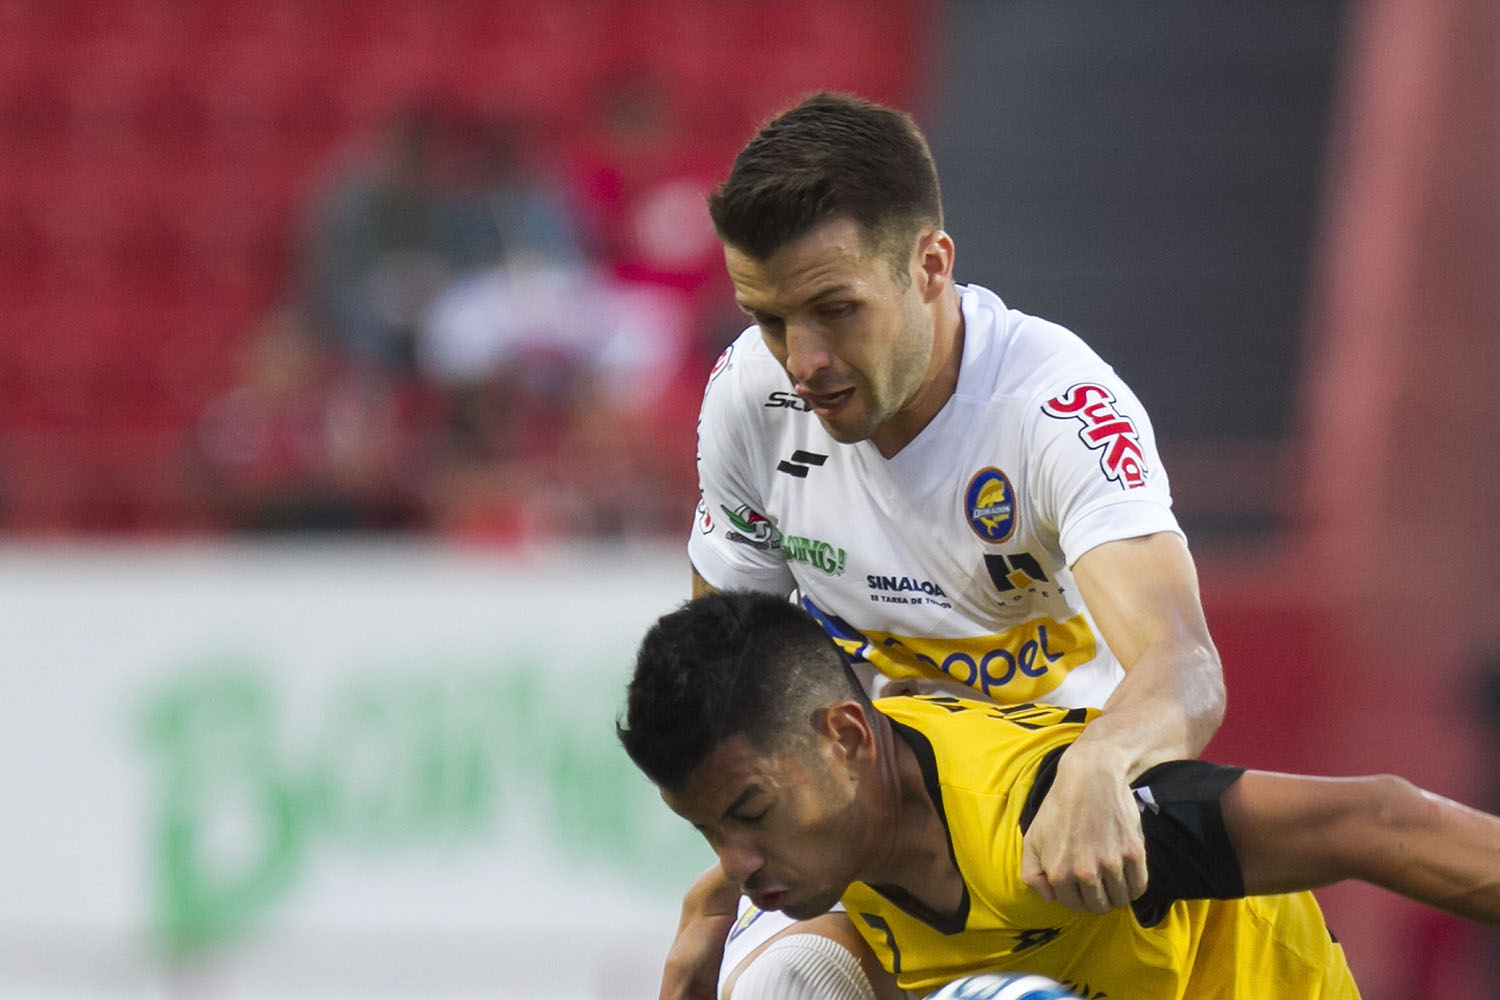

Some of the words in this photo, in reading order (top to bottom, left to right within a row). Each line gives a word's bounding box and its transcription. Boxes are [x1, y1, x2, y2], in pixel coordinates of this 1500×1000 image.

[866, 574, 948, 598] SINALOA
[881, 595, 909, 604] TAREA
[911, 597, 922, 605] DE
